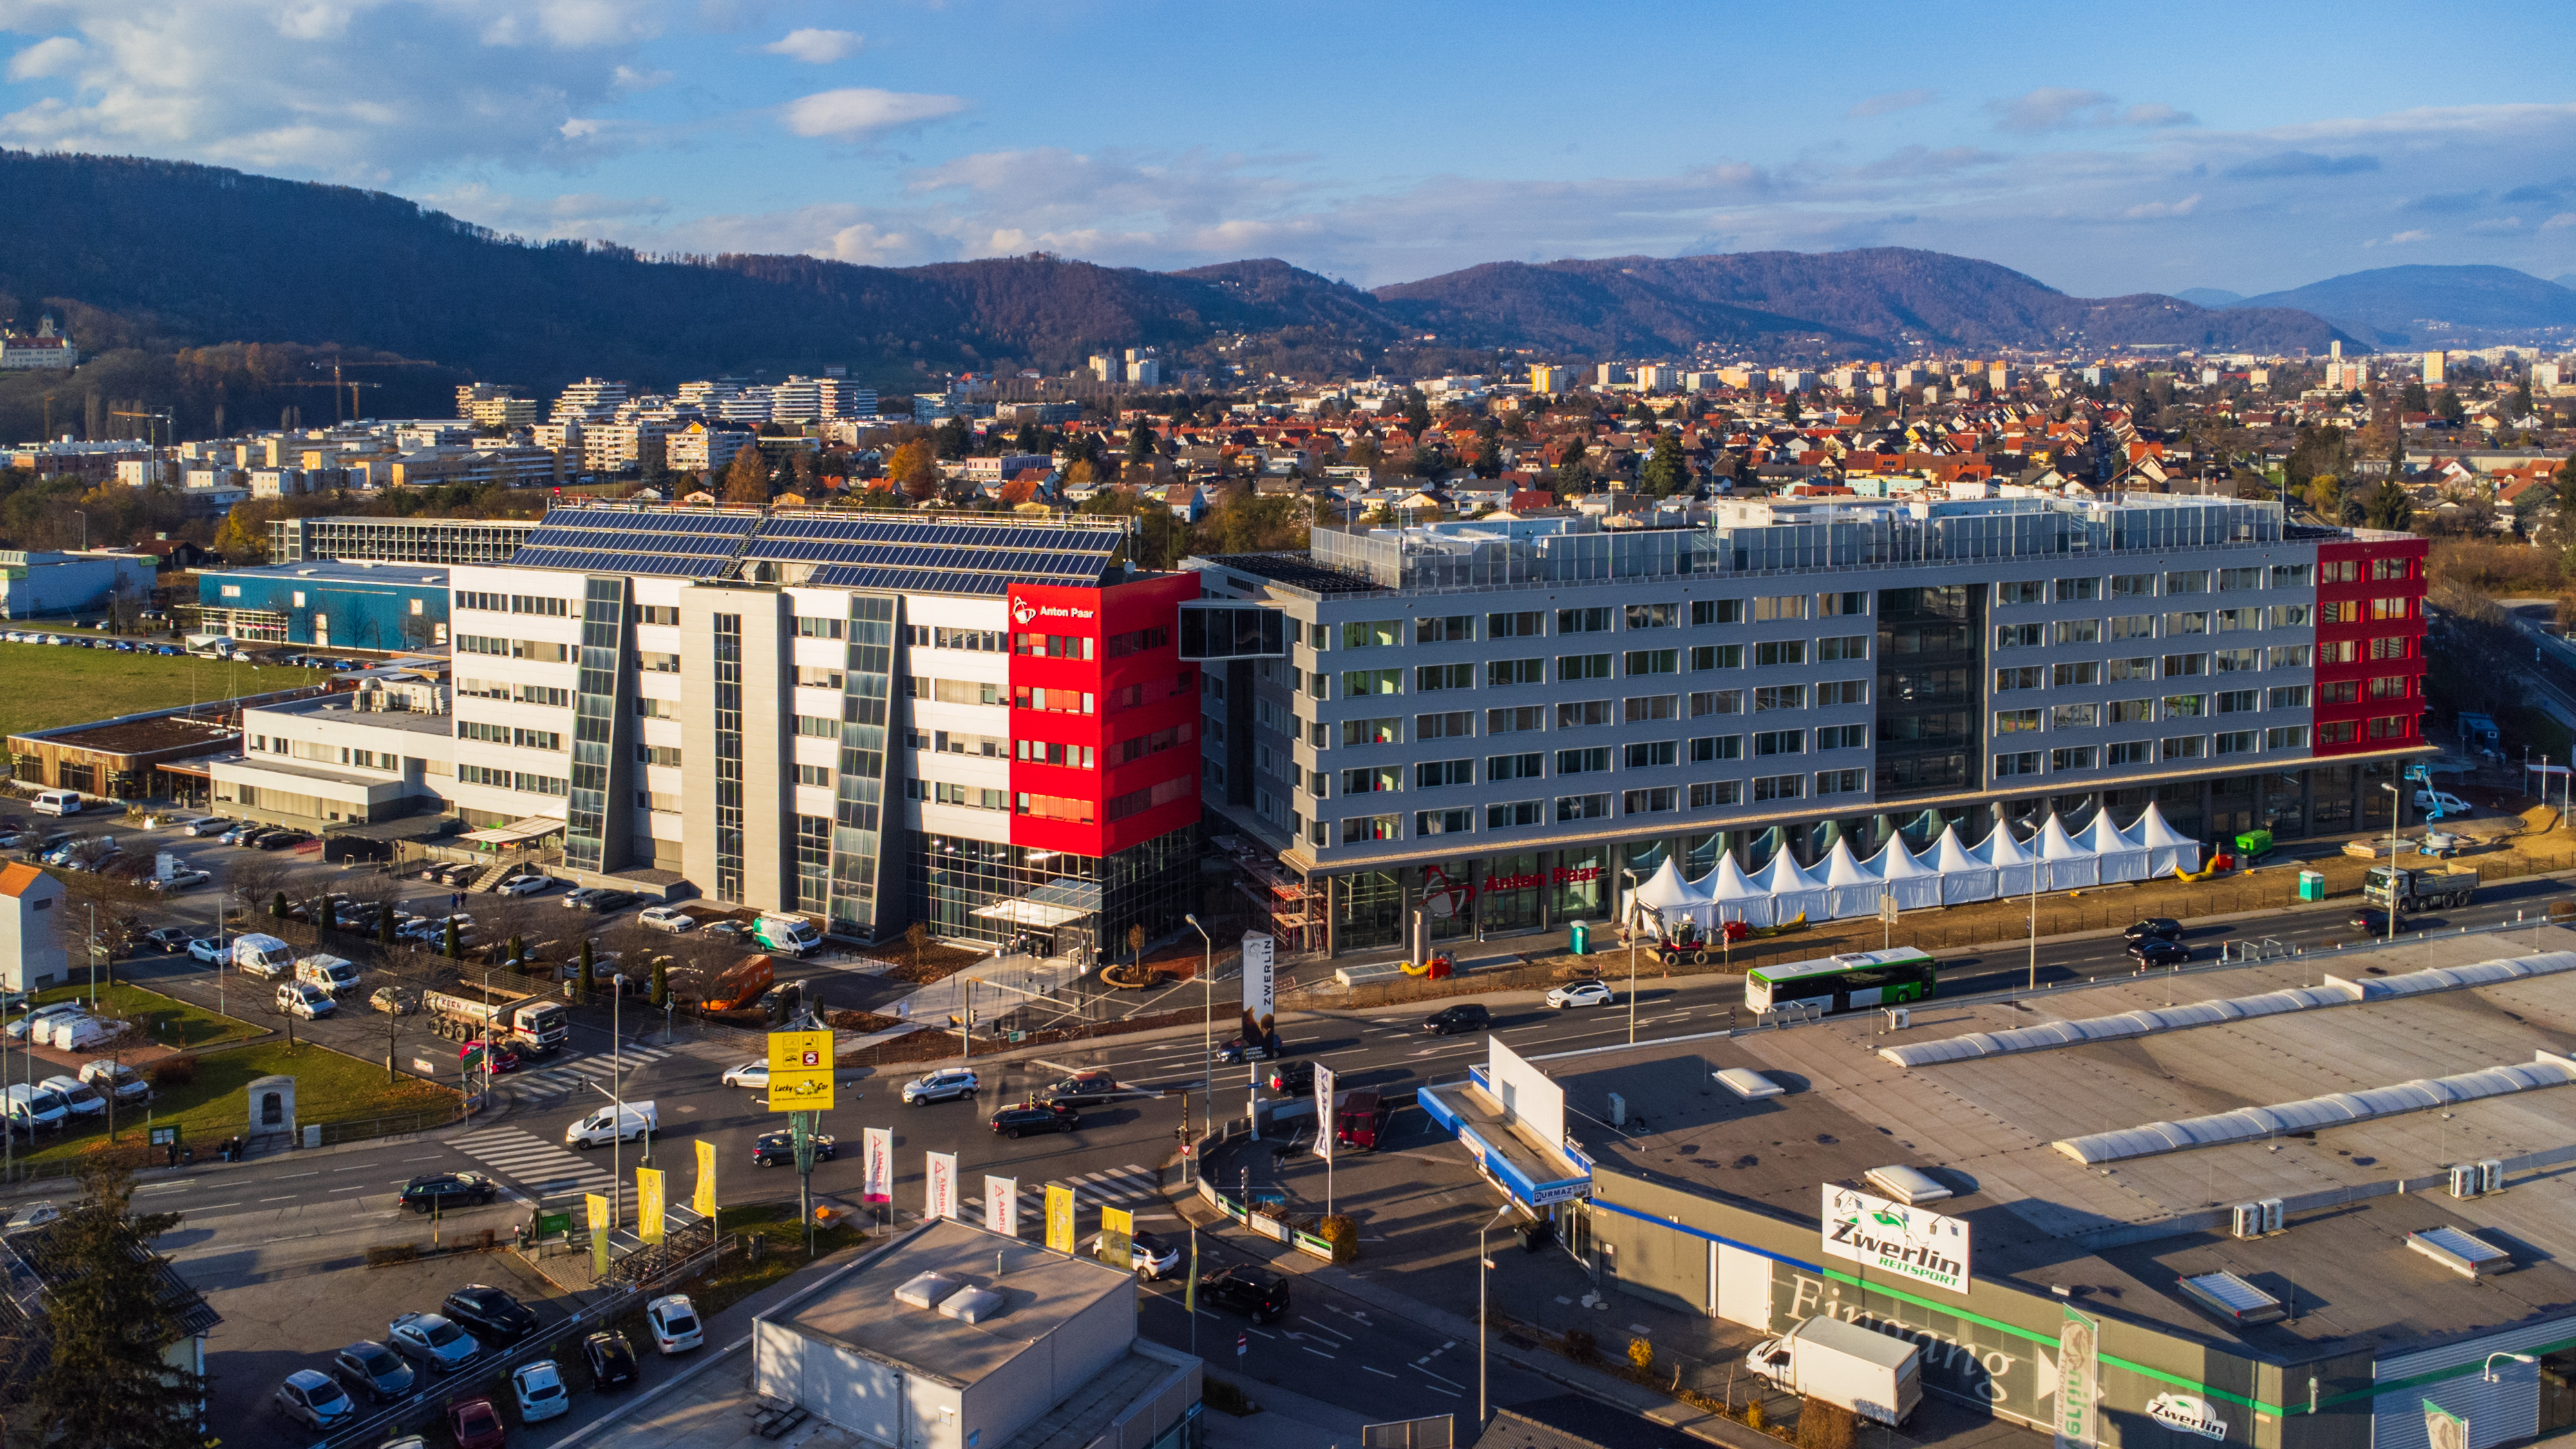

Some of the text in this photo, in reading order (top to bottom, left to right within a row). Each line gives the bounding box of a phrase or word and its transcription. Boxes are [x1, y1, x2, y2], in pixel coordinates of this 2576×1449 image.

[1040, 606, 1094, 618] Anton Paar
[1484, 867, 1600, 893] Anton Paar
[442, 998, 461, 1009] KERN
[774, 1084, 793, 1093] Lucky
[1535, 1188, 1572, 1203] DURMAZ
[1830, 1218, 1962, 1277] Zwerlin
[1879, 1256, 1960, 1286] REITSPORT
[2152, 1402, 2224, 1435] Zwerlin
[2179, 1423, 2222, 1439] REITSPORT
